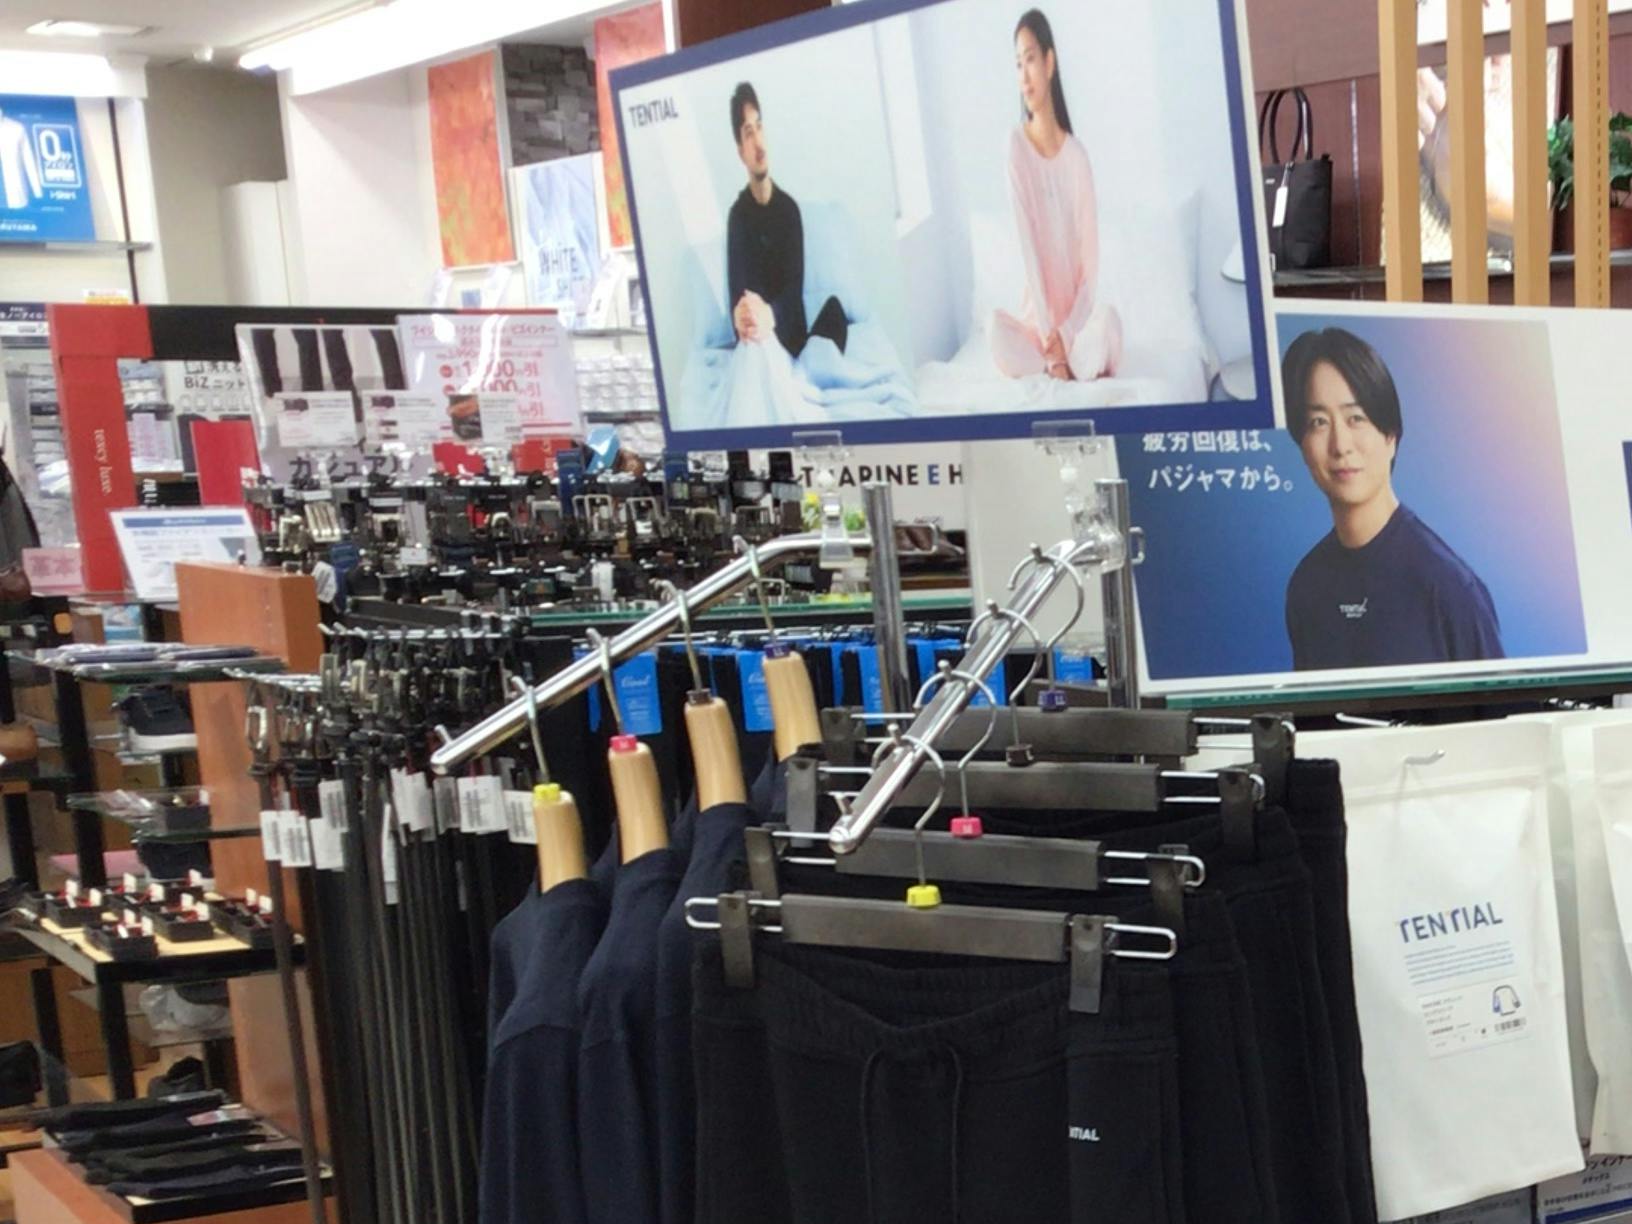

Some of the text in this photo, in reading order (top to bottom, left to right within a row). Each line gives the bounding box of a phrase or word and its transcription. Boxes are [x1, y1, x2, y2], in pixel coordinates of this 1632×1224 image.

[628, 97, 679, 128] TENTIAL
[927, 464, 940, 485] E
[1148, 463, 1294, 493] パジャマから。
[1396, 902, 1504, 943] TENTIAL
